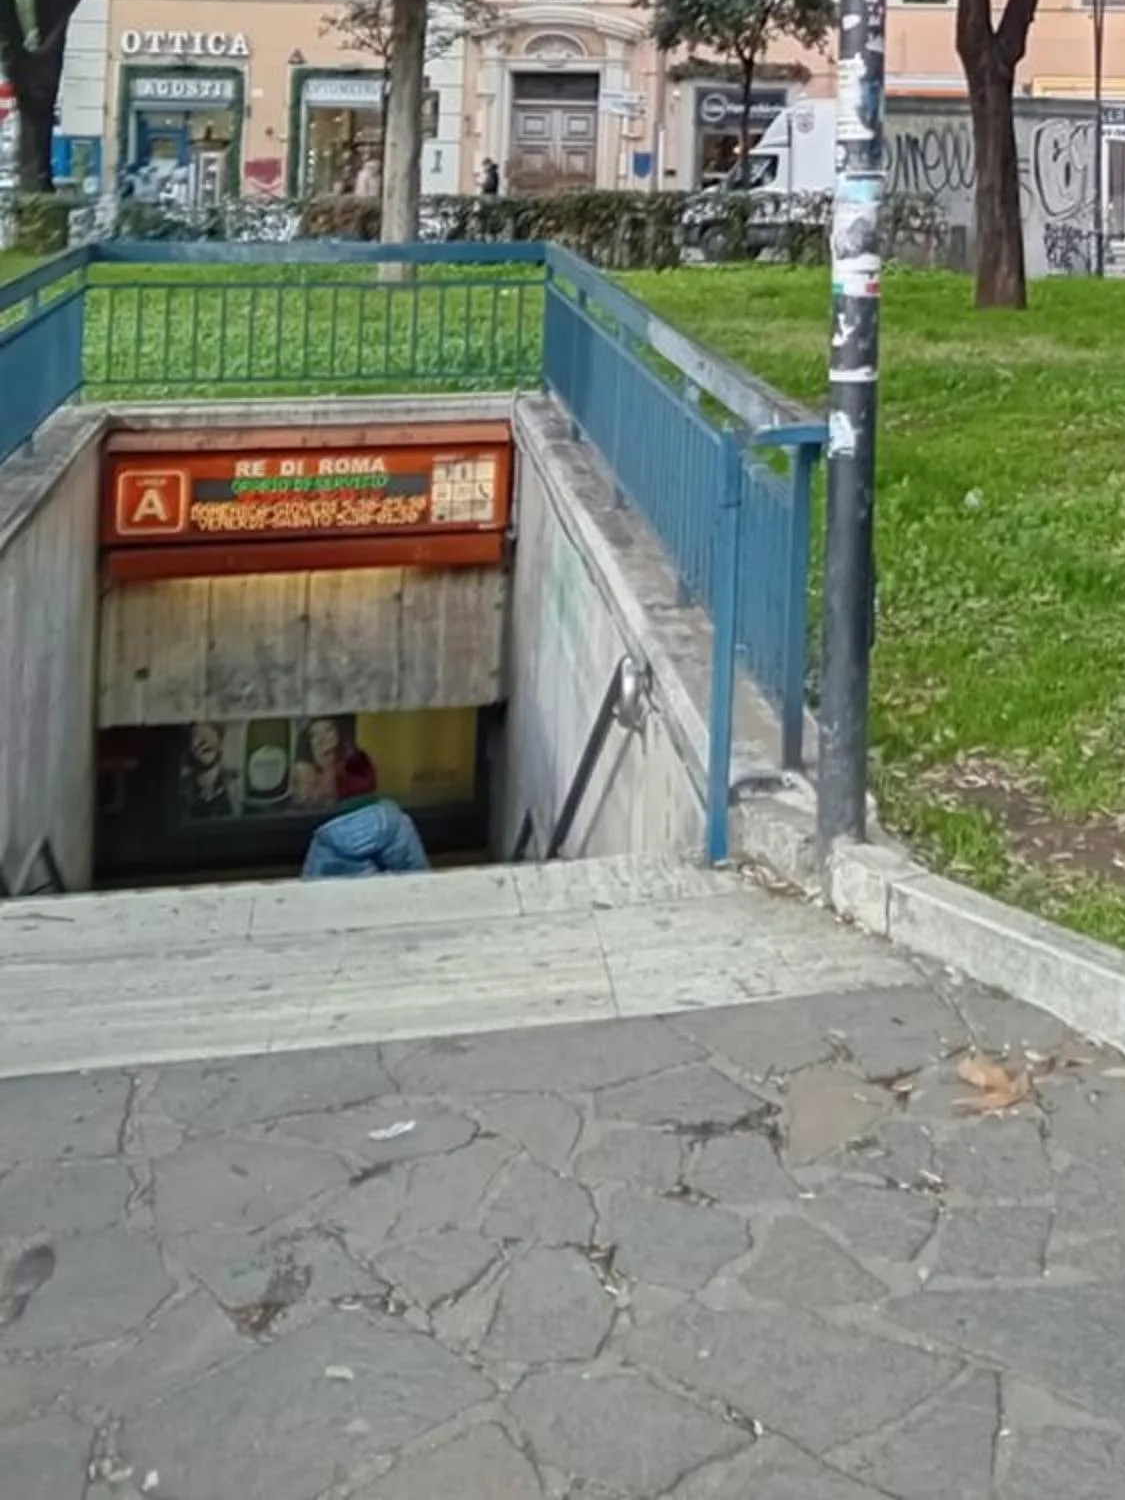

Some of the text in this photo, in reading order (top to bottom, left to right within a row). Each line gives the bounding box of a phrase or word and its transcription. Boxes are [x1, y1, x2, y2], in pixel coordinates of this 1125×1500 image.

[121, 29, 250, 56] OTTICA
[235, 455, 388, 478] RE DI ROMA
[132, 488, 168, 522] A
